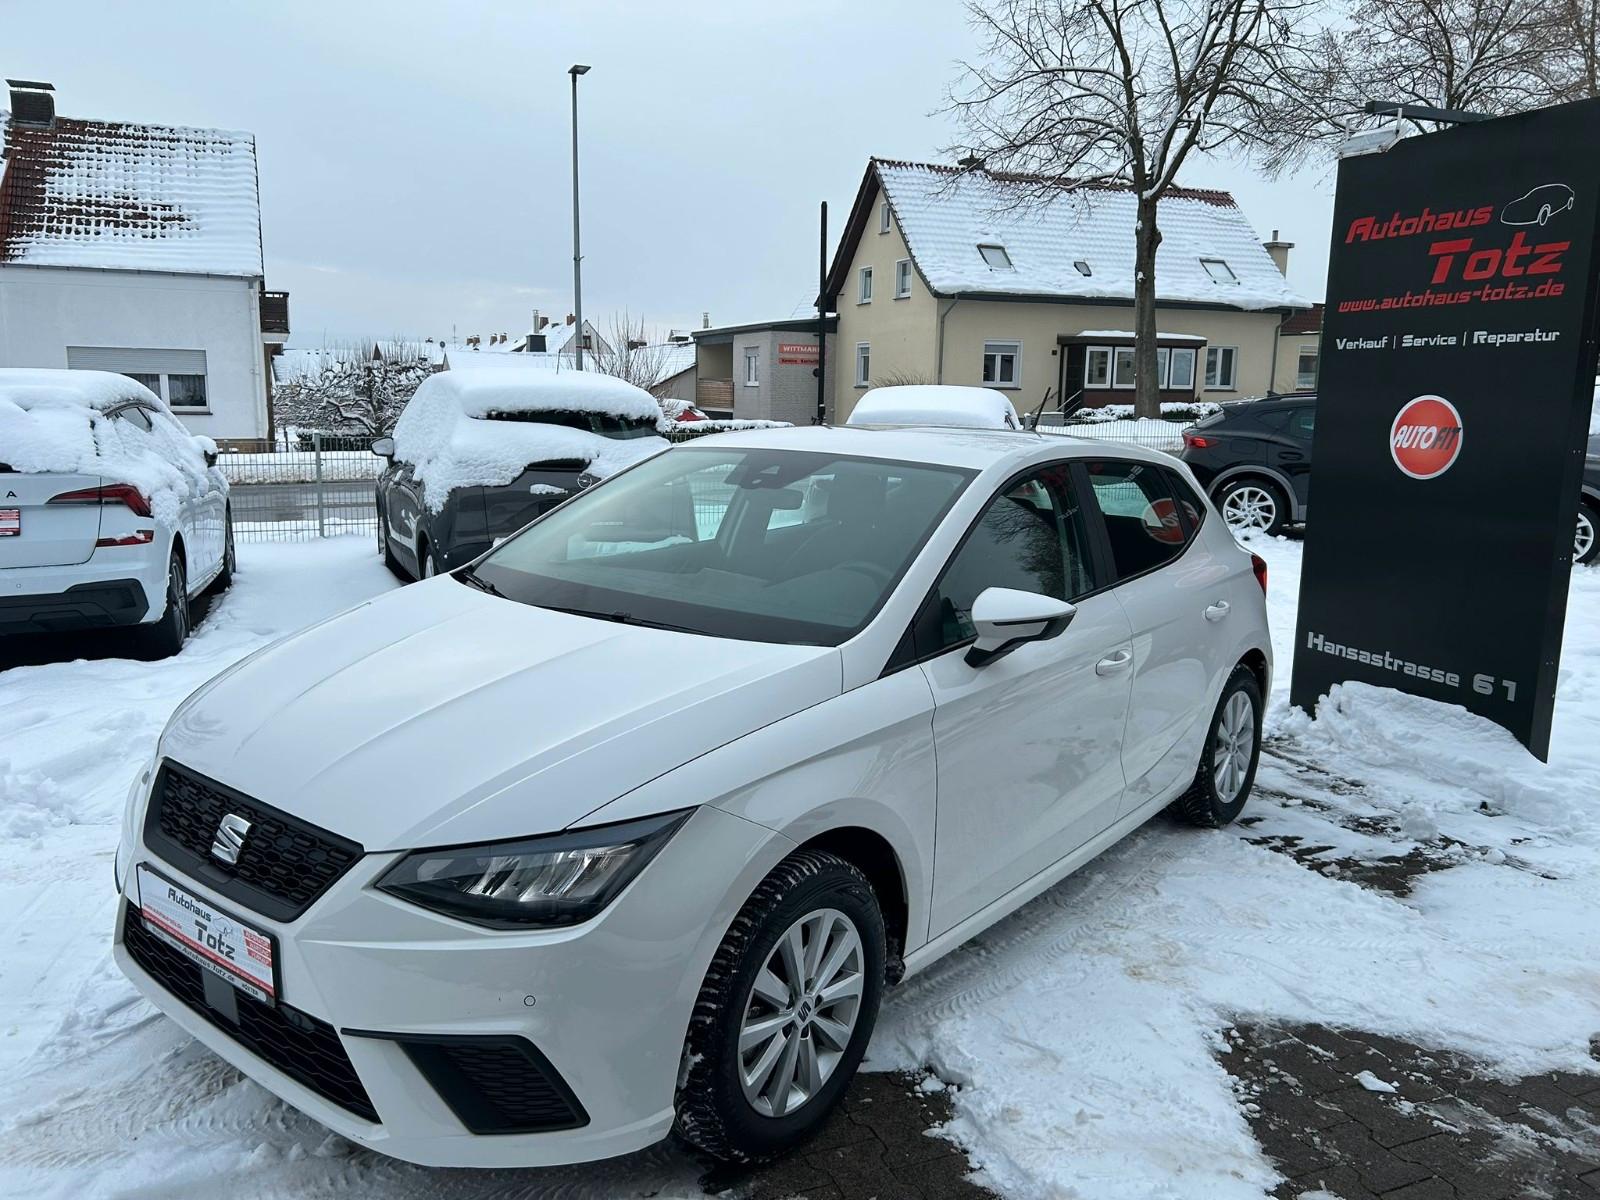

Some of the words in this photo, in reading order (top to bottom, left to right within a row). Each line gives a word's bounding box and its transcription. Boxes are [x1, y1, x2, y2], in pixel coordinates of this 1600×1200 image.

[1345, 205, 1494, 244] Autohaus
[1428, 231, 1572, 284] Totz
[1337, 279, 1565, 313] www.autohaus-totz.de
[783, 345, 820, 353] WITTMAN
[1335, 336, 1388, 350] Verkauf
[1401, 334, 1457, 347] Service
[1472, 328, 1560, 346] Reparatur
[1307, 631, 1460, 688] Hansastrasse
[167, 887, 212, 922] Autohaus
[195, 919, 236, 961] Totz
